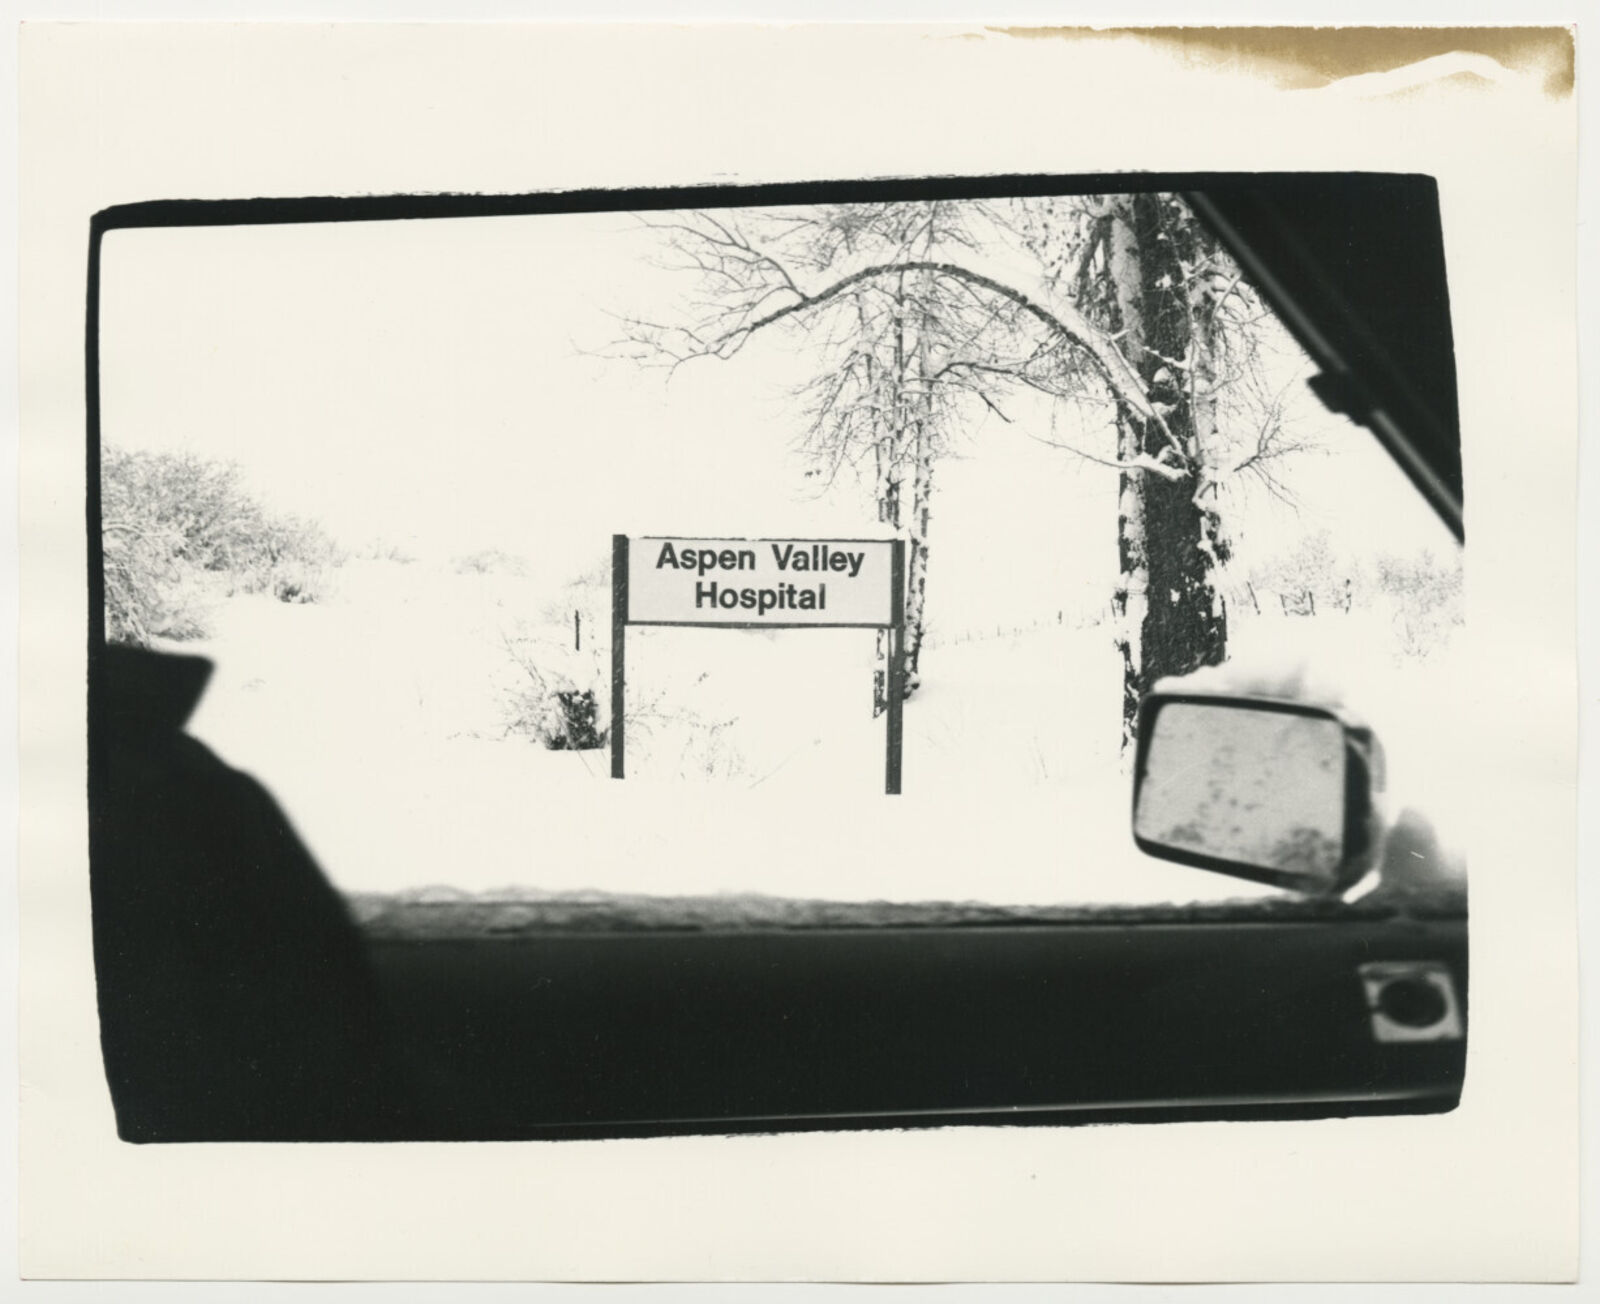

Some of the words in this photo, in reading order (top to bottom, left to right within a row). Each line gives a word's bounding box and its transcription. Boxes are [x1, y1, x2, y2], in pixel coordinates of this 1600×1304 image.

[656, 542, 756, 576] Aspen
[771, 543, 865, 577] Valley
[695, 581, 826, 616] Hospital
